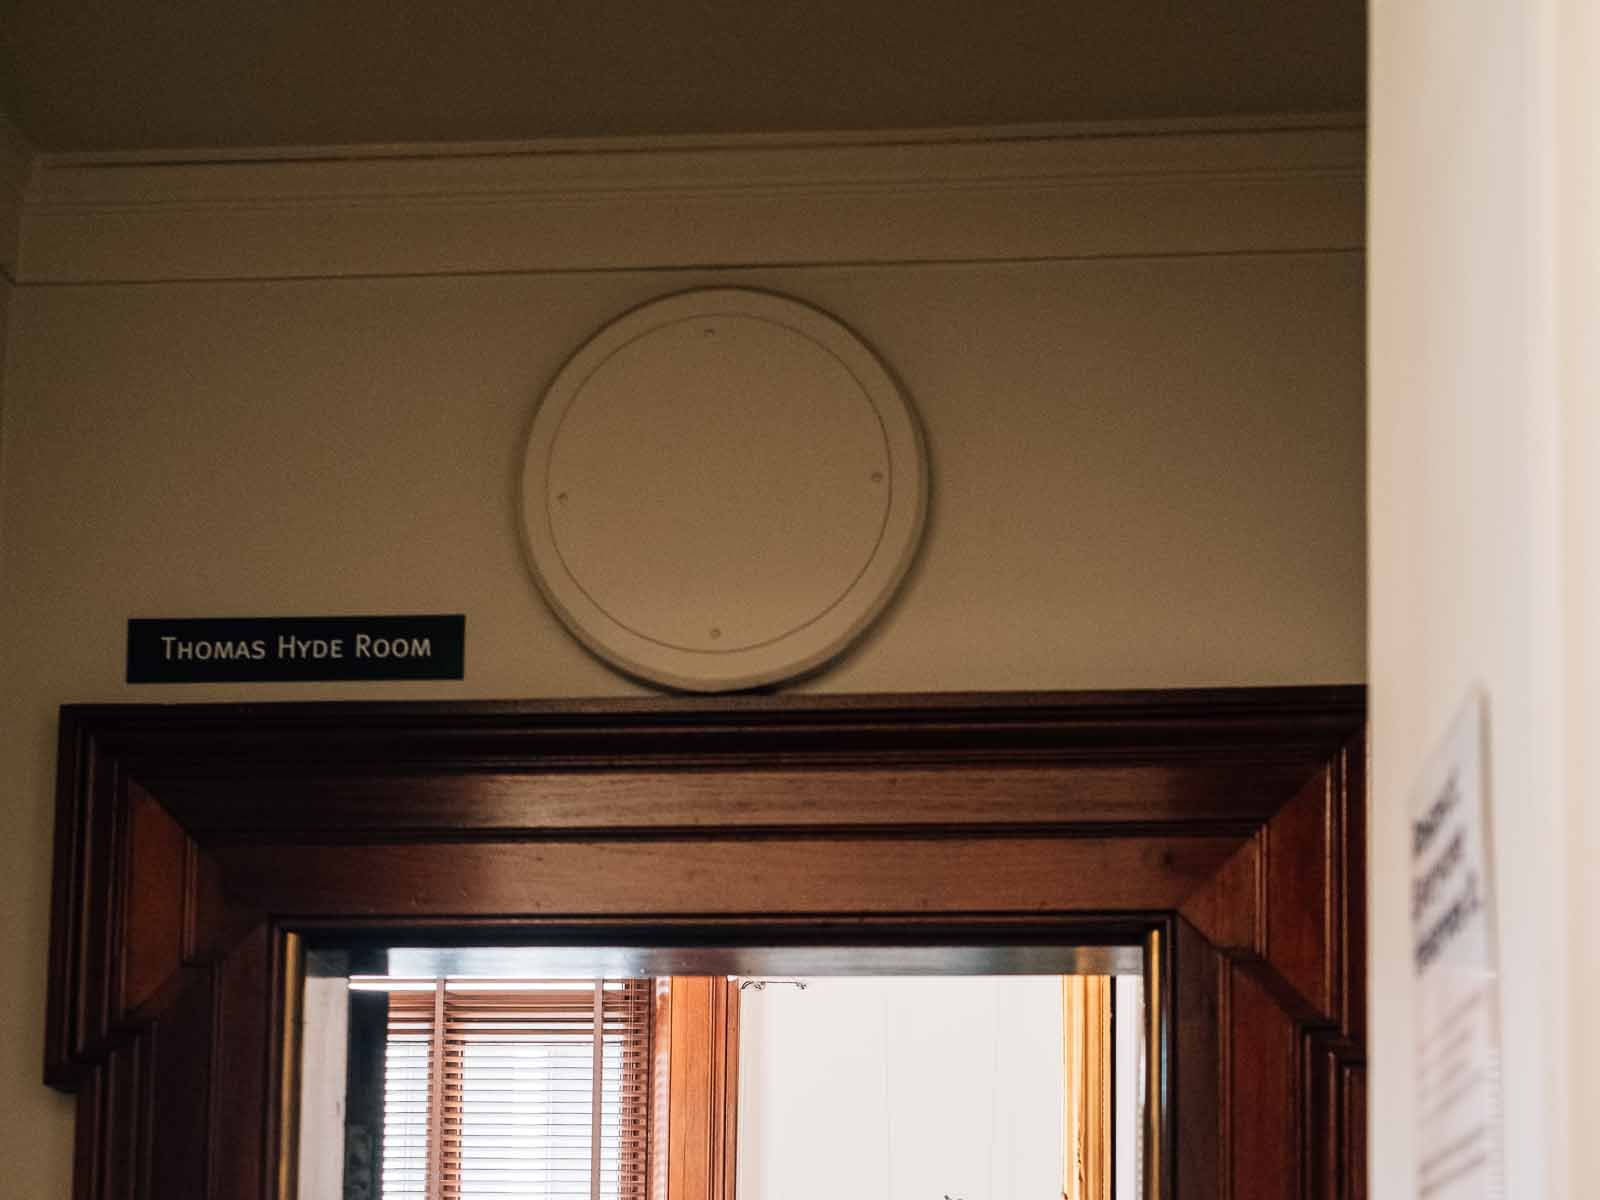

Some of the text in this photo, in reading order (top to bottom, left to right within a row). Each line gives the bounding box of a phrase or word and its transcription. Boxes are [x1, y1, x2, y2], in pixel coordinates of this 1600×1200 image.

[161, 634, 431, 660] THOMAS HYDE ROOM
